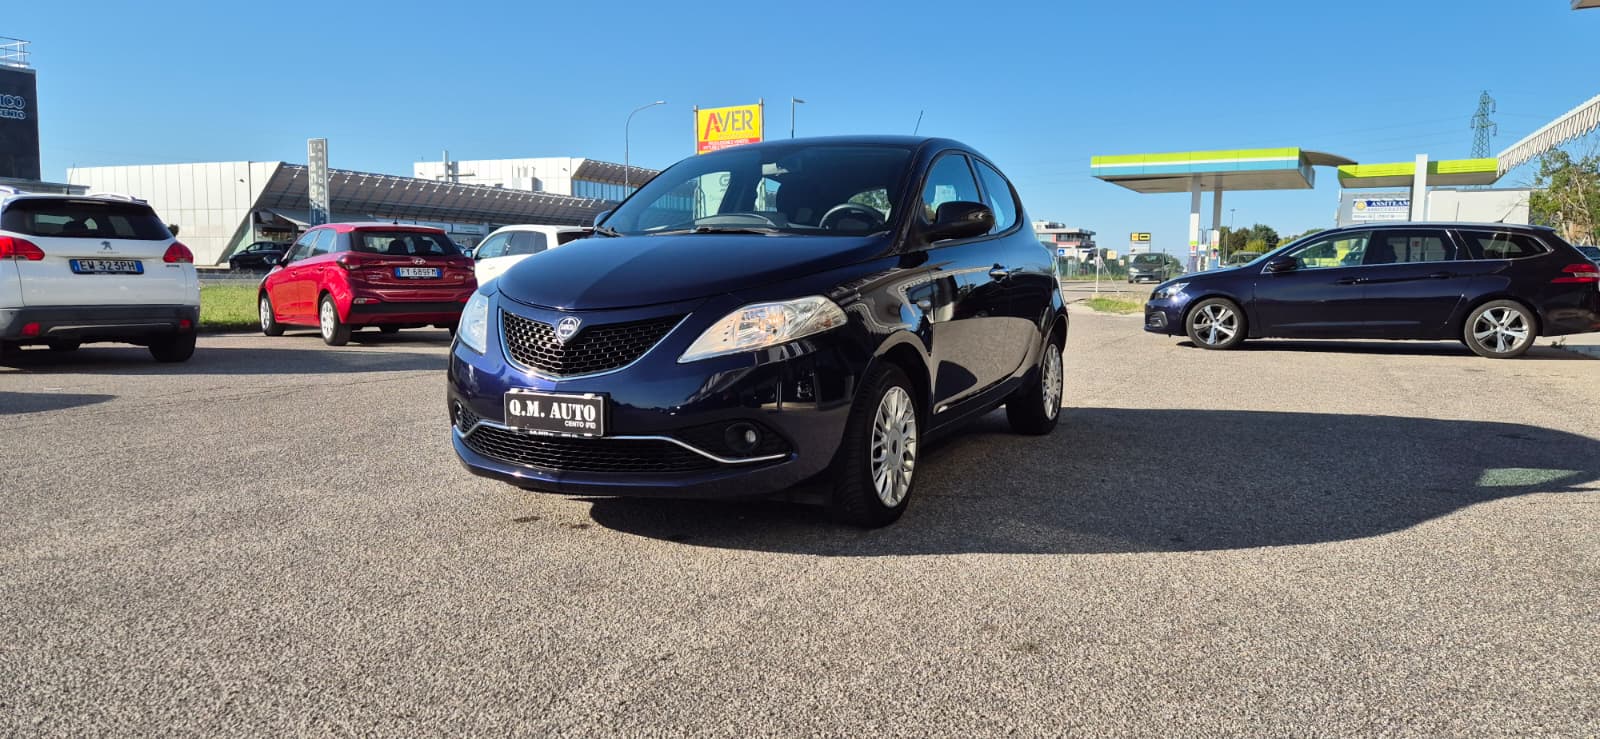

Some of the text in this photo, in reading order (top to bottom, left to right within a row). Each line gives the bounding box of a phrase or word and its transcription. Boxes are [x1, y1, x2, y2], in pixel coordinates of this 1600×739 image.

[704, 110, 753, 140] AVER
[98, 261, 136, 271] 323PH
[509, 399, 596, 421] Q.M. AUTO
